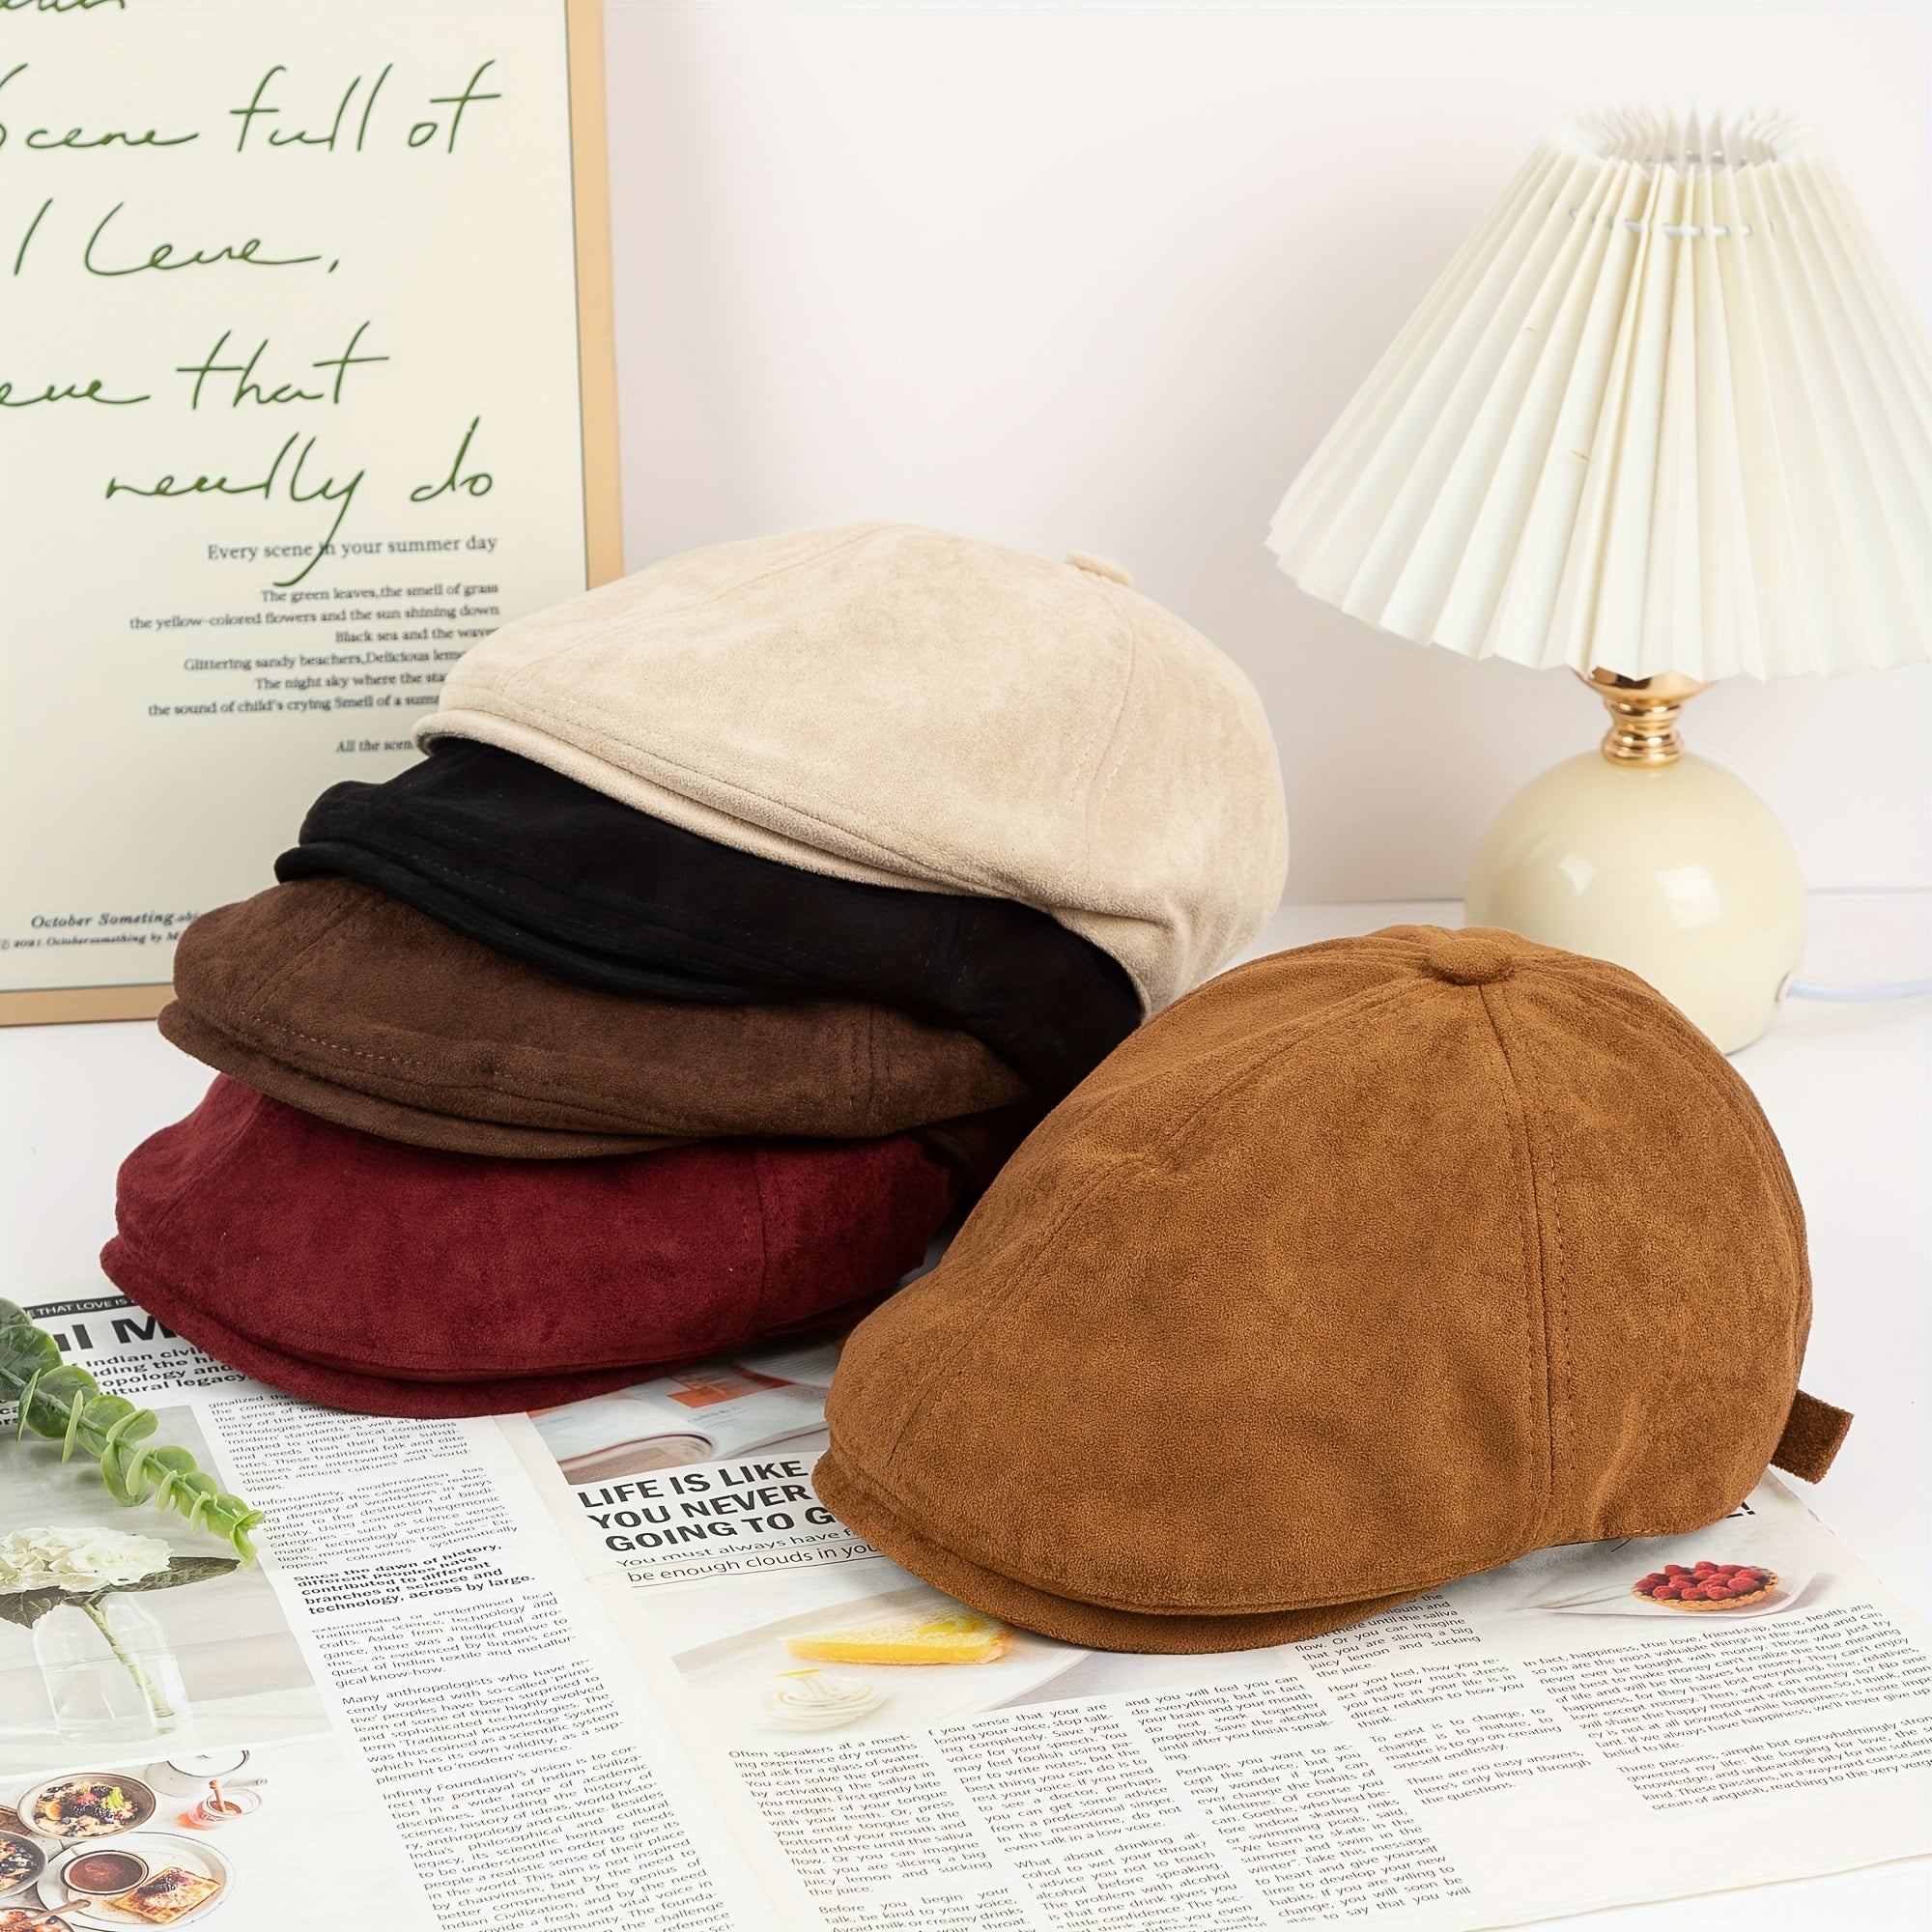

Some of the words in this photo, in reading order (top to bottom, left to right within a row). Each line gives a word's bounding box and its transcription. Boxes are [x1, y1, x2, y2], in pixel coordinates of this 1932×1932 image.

[229, 63, 393, 153] full
[176, 320, 389, 410] that
[411, 415, 494, 501] do
[208, 544, 258, 562] Every
[263, 544, 313, 556] scene
[319, 541, 336, 555] in
[341, 542, 383, 558] your
[386, 539, 461, 553] summer
[466, 534, 497, 553] day
[261, 589, 287, 602] The
[291, 590, 329, 604] green
[406, 583, 443, 596] smell
[445, 582, 461, 595] of
[463, 583, 498, 597] grass
[129, 616, 153, 630] the
[156, 612, 262, 631] yellow-colored
[265, 611, 317, 624] flowers
[321, 609, 347, 621] and
[350, 608, 372, 620] the
[377, 609, 402, 619] sun
[405, 607, 456, 619] shining
[459, 605, 499, 616] down
[335, 630, 373, 642] Black
[376, 632, 399, 640] sea
[401, 628, 428, 639] and
[432, 627, 454, 639] the
[184, 658, 252, 670] Glittering
[255, 655, 296, 668] sandy
[255, 677, 282, 690] The
[284, 675, 322, 690] night
[326, 674, 349, 688] sky
[353, 673, 396, 685] where
[400, 671, 422, 684] the
[148, 703, 171, 716] the
[174, 701, 217, 715] sound
[219, 700, 236, 713] of
[237, 699, 284, 713] child's
[286, 697, 331, 713] crying
[334, 695, 374, 708] Smell
[376, 694, 391, 706] of
[393, 696, 402, 706] a
[335, 739, 355, 753] All
[358, 739, 380, 752] the
[31, 914, 93, 929] October
[150, 932, 162, 943] by
[38, 1304, 73, 1316] THAT
[76, 1299, 112, 1312] LOVE
[85, 1352, 153, 1367] Indian
[153, 1358, 187, 1370] the
[98, 1369, 186, 1388] opology
[193, 1363, 234, 1376] and
[578, 1479, 664, 1508] LIFE
[668, 1473, 711, 1495] IS
[718, 1460, 810, 1488] LIKE
[586, 1505, 671, 1529] YOU
[679, 1484, 812, 1518] NEVER
[605, 1521, 738, 1551] GOING
[740, 1512, 795, 1533] TO
[615, 1557, 656, 1569] You
[662, 1548, 713, 1560] must
[719, 1539, 786, 1555] always
[789, 1531, 840, 1544] have
[294, 1572, 339, 1581] Since
[344, 1567, 370, 1576] the
[375, 1561, 418, 1572] dawn
[423, 1556, 439, 1565] of
[298, 1573, 369, 1587] different
[373, 1567, 436, 1579] peoples
[440, 1555, 477, 1569] have
[301, 1577, 396, 1596] contributed
[400, 1575, 416, 1583] to
[421, 1560, 492, 1581] different
[627, 1572, 655, 1582] be
[660, 1560, 741, 1577] enough
[746, 1550, 813, 1568] clouds
[816, 1548, 838, 1559] in
[305, 1587, 382, 1605] branches
[386, 1584, 402, 1594] of
[405, 1574, 469, 1591] science
[473, 1567, 503, 1580] and
[308, 1594, 404, 1614] technology,
[409, 1584, 463, 1599] across
[466, 1582, 485, 1592] by
[488, 1574, 535, 1587] large.
[1522, 1660, 1537, 1668] In
[1539, 1655, 1569, 1665] fact,
[1570, 1644, 1640, 1660] happiness,
[1641, 1640, 1666, 1650] true
[1669, 1635, 1701, 1646] love,
[1702, 1625, 1771, 1640] friendship,
[1772, 1619, 1805, 1631] time,
[1805, 1607, 1847, 1623] health
[335, 1676, 367, 1690] gical
[370, 1665, 446, 1683] know-how.
[342, 1693, 380, 1705] Many
[386, 1676, 493, 1699] anthropologists
[497, 1671, 528, 1682] who
[532, 1664, 566, 1677] have
[571, 1659, 590, 1668] re-
[1125, 1697, 1151, 1707] and
[1155, 1693, 1180, 1703] you
[1185, 1688, 1209, 1697] will
[1214, 1684, 1239, 1692] feel
[1243, 1680, 1269, 1690] you
[1357, 1716, 1396, 1728] think.
[728, 1750, 769, 1759] Often
[774, 1746, 834, 1758] speakers
[838, 1742, 852, 1750] at
[870, 1734, 910, 1747] meet-
[1176, 1762, 1231, 1776] Perhaps
[1237, 1757, 1264, 1768] you
[1269, 1749, 1304, 1761] want
[1333, 1744, 1353, 1752] ac-
[1393, 1754, 1441, 1770] oneself
[1443, 1742, 1509, 1761] endlessly.
[1603, 1747, 1641, 1758] belief
[1659, 1742, 1684, 1750] life.
[1405, 1775, 1444, 1785] There
[1447, 1769, 1468, 1778] are
[1471, 1763, 1491, 1773] no
[1493, 1758, 1522, 1769] easy
[1526, 1749, 1584, 1764] answers,
